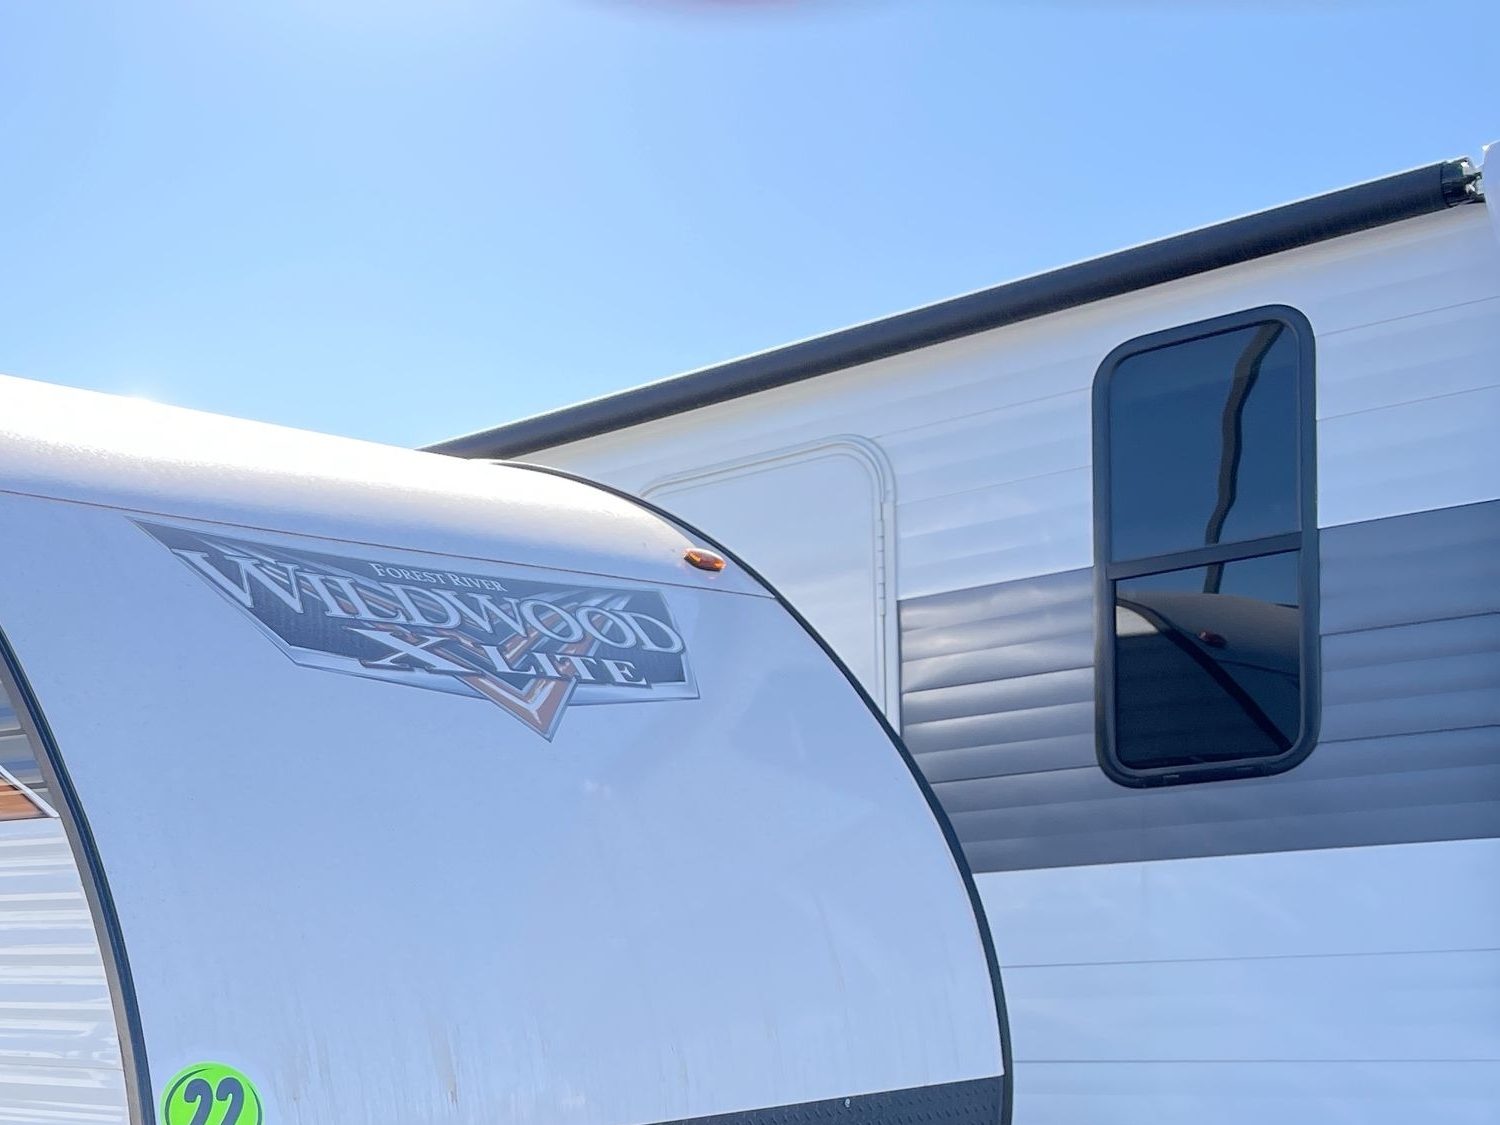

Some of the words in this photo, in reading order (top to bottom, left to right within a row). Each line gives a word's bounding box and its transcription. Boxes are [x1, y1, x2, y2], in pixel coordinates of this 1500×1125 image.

[172, 549, 686, 654] WILDWOOD
[369, 562, 446, 584] FOREST
[444, 572, 508, 592] RIVER
